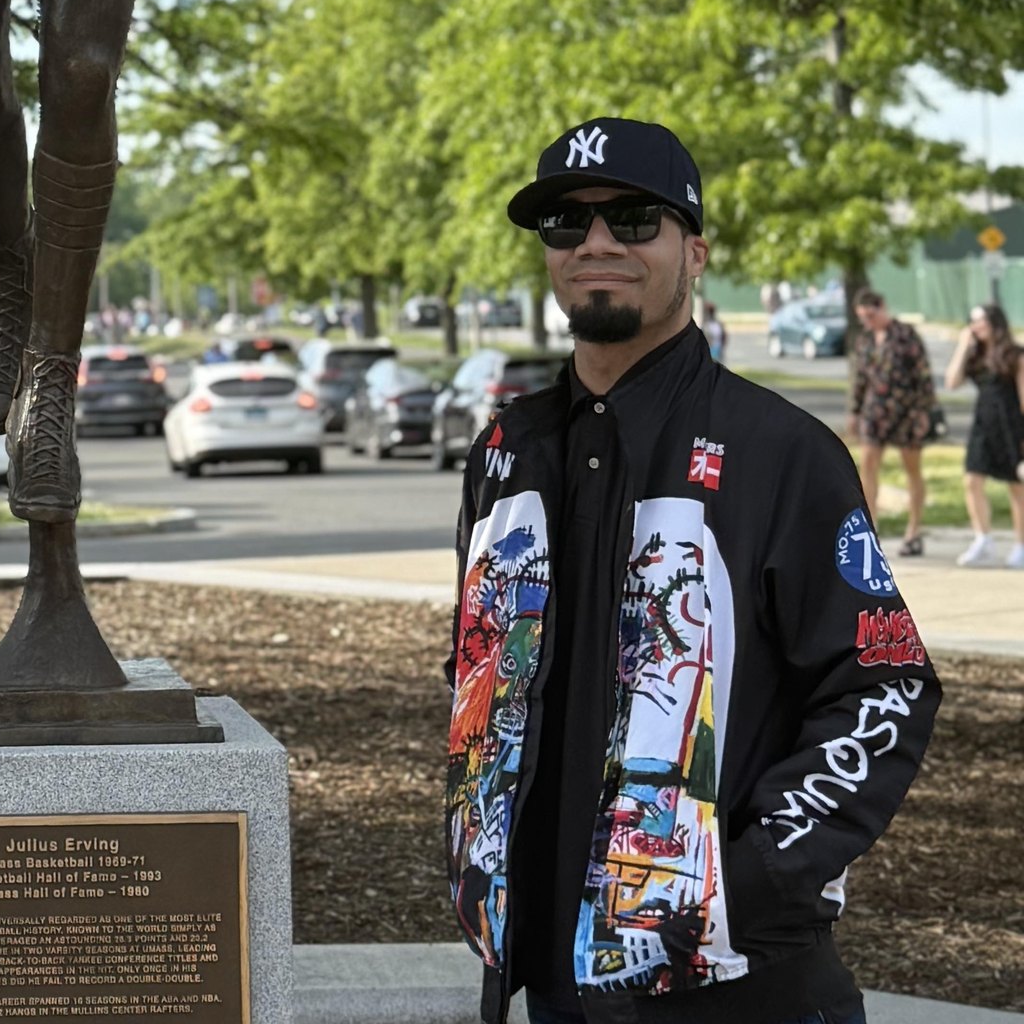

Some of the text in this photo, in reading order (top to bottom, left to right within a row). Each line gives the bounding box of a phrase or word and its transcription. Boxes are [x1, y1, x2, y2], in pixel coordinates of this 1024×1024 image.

[565, 126, 608, 168] NY
[6, 837, 119, 854] Julius Erving
[26, 856, 93, 868] Basketball
[98, 856, 145, 866] 1969-71
[36, 872, 61, 883] Hall
[66, 872, 78, 882] of
[83, 871, 117, 882] Fame
[133, 870, 162, 882] 1993
[24, 887, 48, 898] Hall
[53, 886, 66, 898] of
[70, 886, 104, 898] Fame
[120, 885, 150, 896] 1980
[48, 916, 97, 924] REGARDED
[100, 916, 111, 924] AS
[114, 916, 132, 924] ONE
[135, 914, 146, 923] OF
[150, 914, 167, 922] THE
[170, 914, 194, 922] MOST
[197, 913, 222, 922] ELITE
[66, 926, 99, 934] KNOWN
[117, 925, 134, 933] THE
[136, 924, 168, 933] WORLD
[170, 924, 202, 932] SIMPLY
[204, 924, 216, 932] AS
[54, 935, 112, 944] ASTOUNDING
[134, 934, 167, 943] POINTS
[170, 934, 188, 942] AND
[11, 947, 20, 955] IN
[45, 946, 82, 954] VARSITY
[85, 945, 127, 954] SEASONS
[129, 944, 140, 953] AT
[178, 944, 216, 952] LEADING
[0, 956, 65, 966] BACK-TO-BACK
[68, 956, 102, 964] YANKEE
[105, 954, 166, 964] CONFERENCE
[168, 954, 198, 962] TITLES
[200, 954, 219, 962] AND
[66, 966, 76, 974] IN
[117, 966, 140, 974] ONLY
[142, 965, 168, 973] ONCE
[170, 964, 180, 972] IN
[182, 964, 197, 972] HIS
[28, 977, 40, 985] HE
[44, 976, 62, 984] FAIL
[64, 976, 76, 984] TO
[78, 976, 116, 984] RECORD
[118, 976, 124, 984] A
[28, 996, 73, 1006] SPANNED
[86, 996, 128, 1004] SEASONS
[130, 996, 139, 1004] IN
[142, 995, 160, 1004] THE
[161, 995, 178, 1003] ABA
[181, 994, 198, 1003] AND
[6, 1008, 36, 1016] HANGS
[39, 1008, 48, 1016] IN
[52, 1007, 68, 1015] THE
[71, 1006, 109, 1014] MULLINS
[112, 1006, 148, 1014] CENTER
